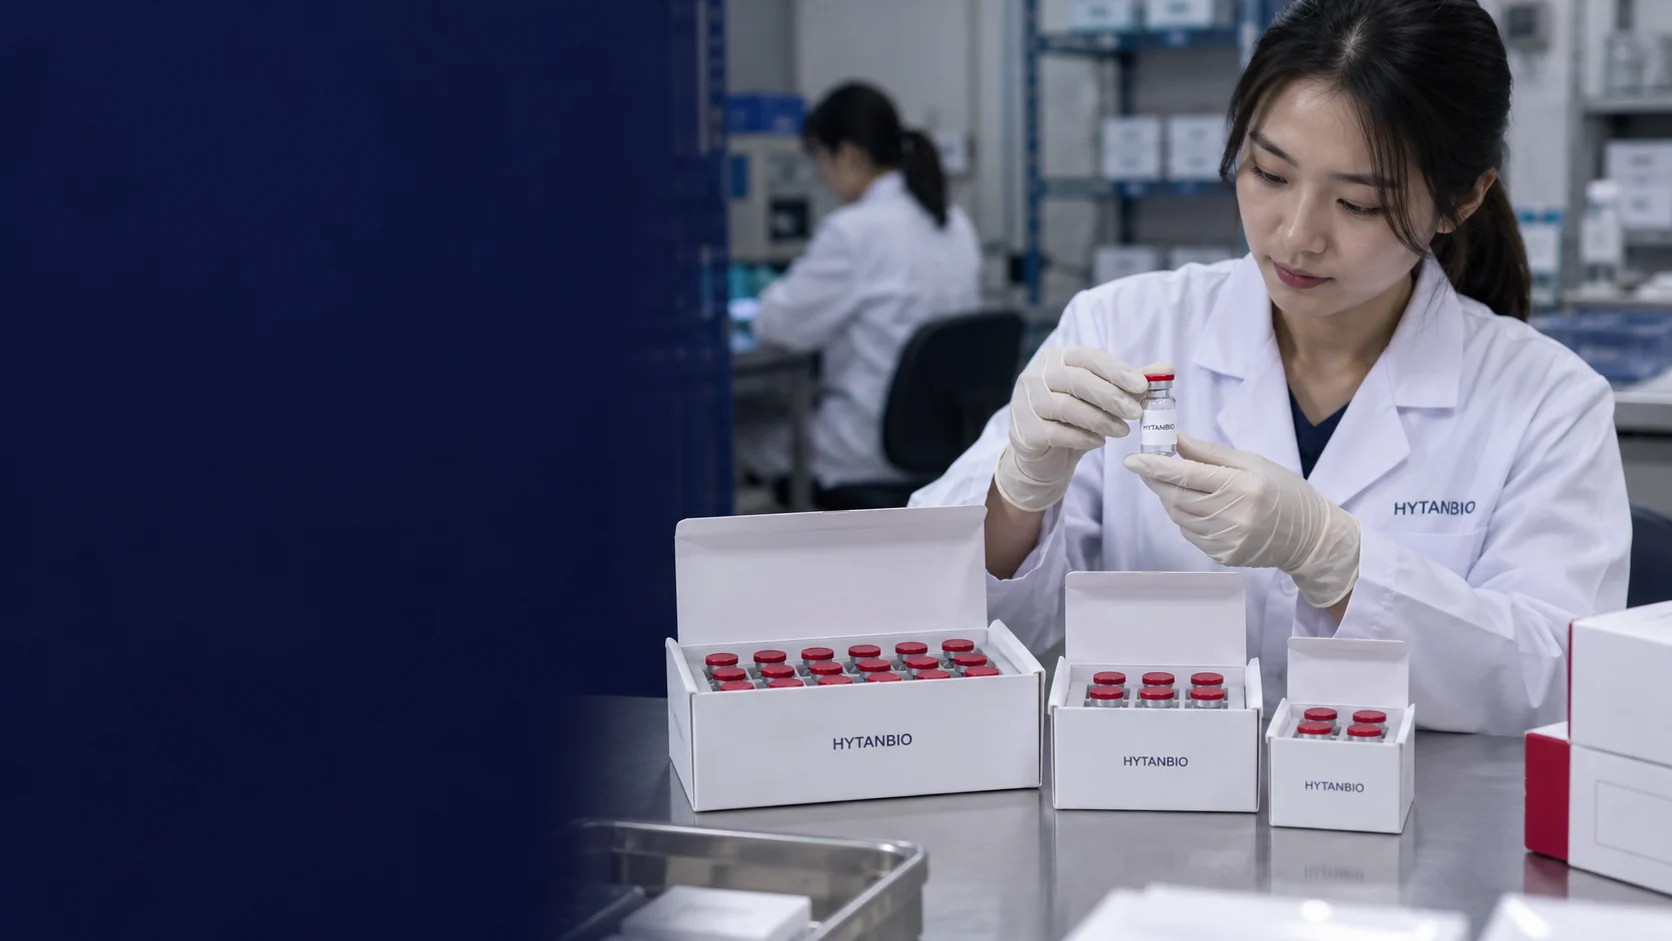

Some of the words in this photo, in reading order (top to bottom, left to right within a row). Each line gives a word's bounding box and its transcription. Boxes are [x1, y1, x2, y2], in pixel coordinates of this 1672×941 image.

[1394, 500, 1476, 516] HYTANBIO
[833, 733, 913, 750] HYTANBIO
[1123, 756, 1189, 767] HYTANBIO
[1305, 780, 1365, 793] HYTANBIO
